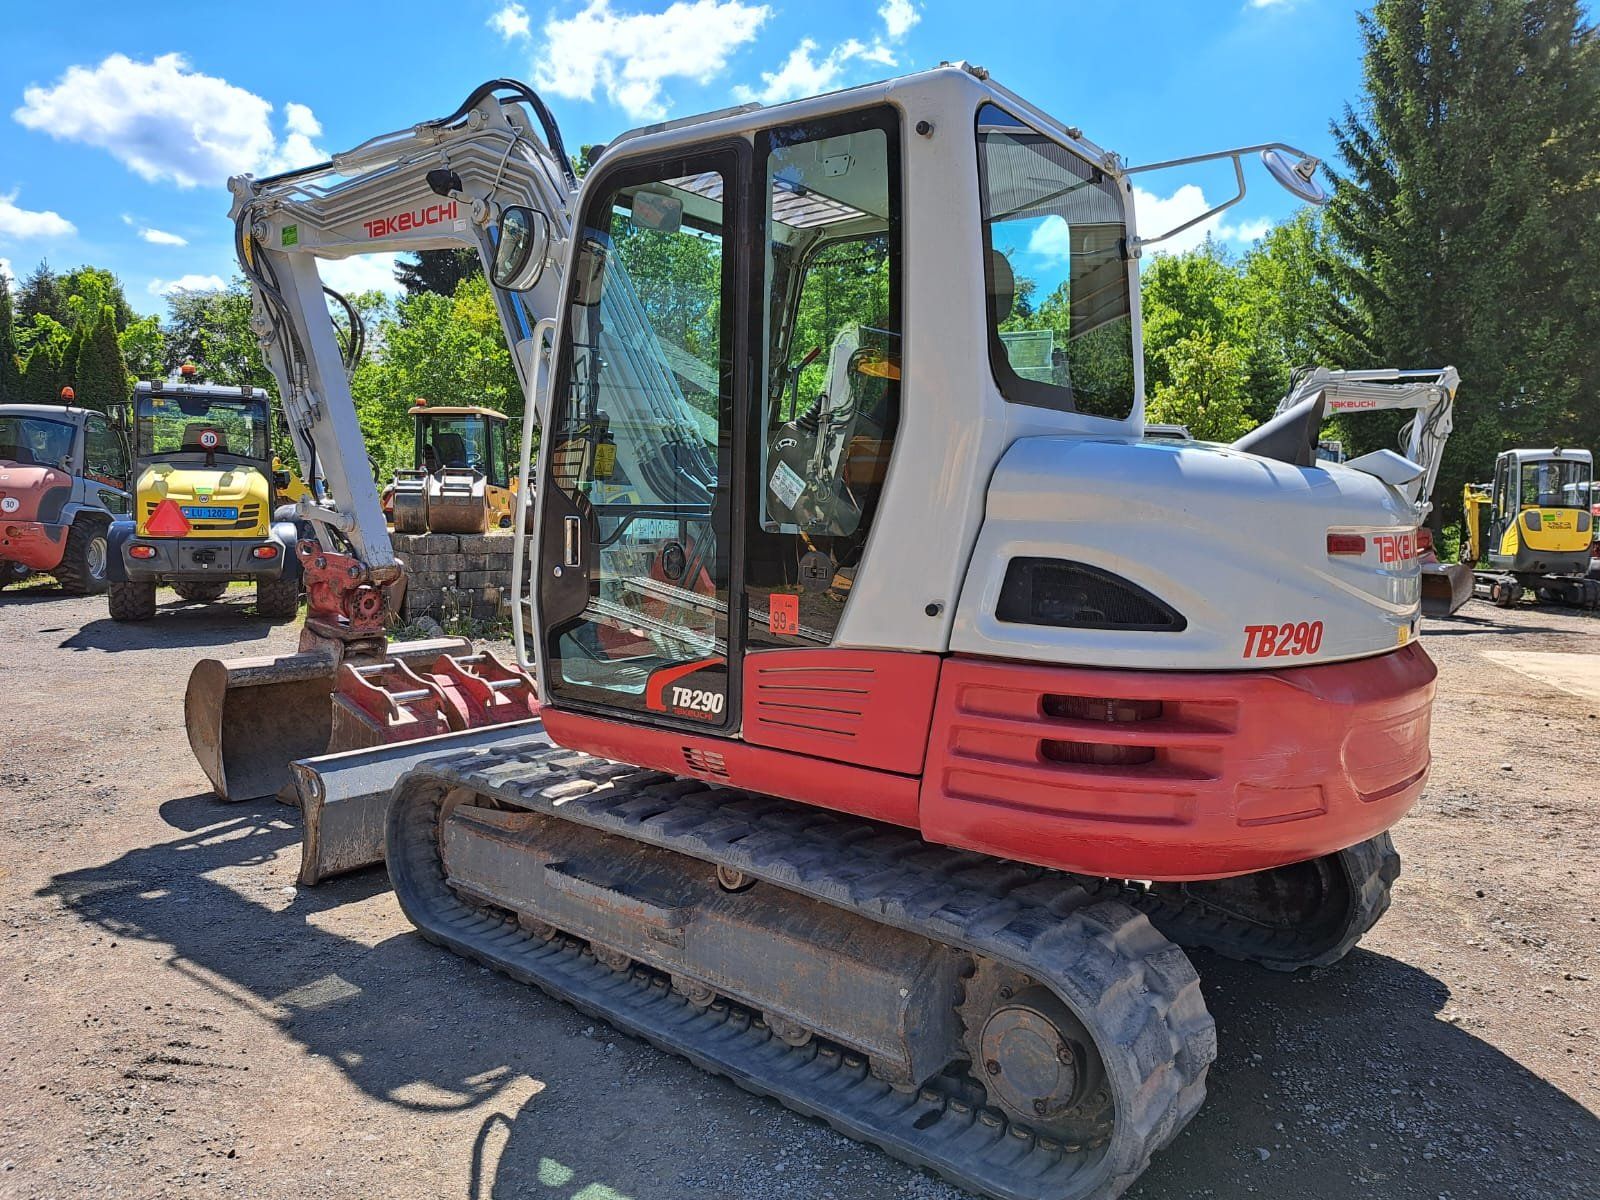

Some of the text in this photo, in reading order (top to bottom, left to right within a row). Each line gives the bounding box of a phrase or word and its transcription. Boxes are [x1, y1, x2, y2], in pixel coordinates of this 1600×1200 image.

[363, 201, 457, 238] TAKEUCHI
[1328, 400, 1376, 408] TAKEUCHI
[203, 435, 215, 444] 30
[4, 500, 15, 509] 30
[208, 509, 227, 518] 1202
[773, 611, 787, 630] 99
[1243, 620, 1323, 658] TB290
[672, 686, 724, 714] TB290
